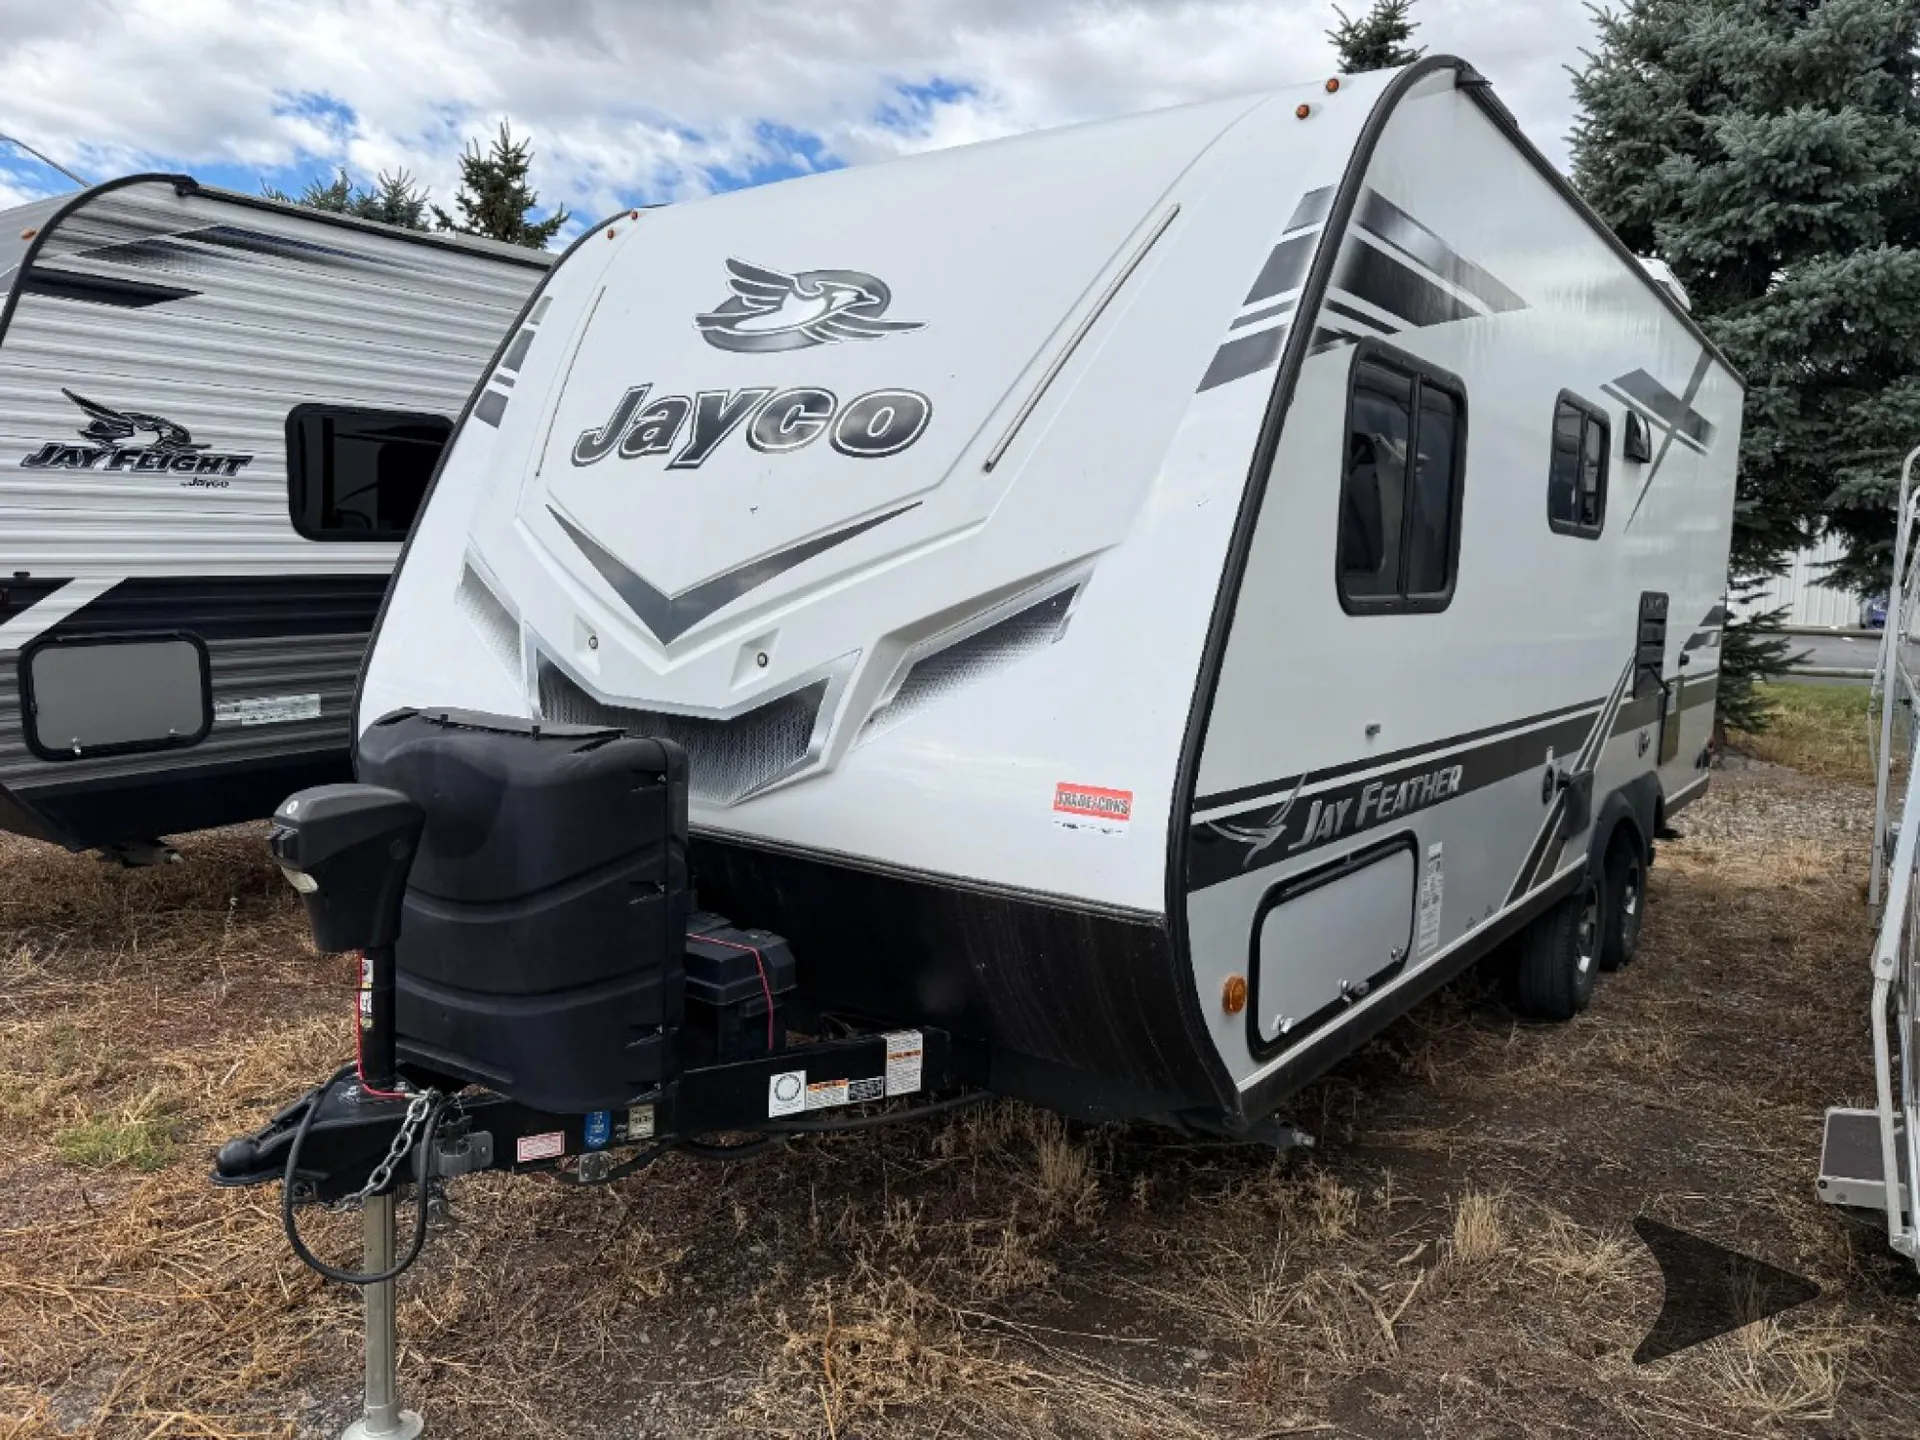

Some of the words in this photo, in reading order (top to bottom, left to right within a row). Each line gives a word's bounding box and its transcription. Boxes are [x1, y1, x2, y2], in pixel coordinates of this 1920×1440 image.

[571, 382, 933, 471] Jayco
[20, 442, 107, 469] JAY
[102, 449, 254, 476] FLIGHT
[189, 477, 230, 488] Jayco
[1288, 798, 1353, 851] JAY
[1355, 765, 1463, 828] FEATHER
